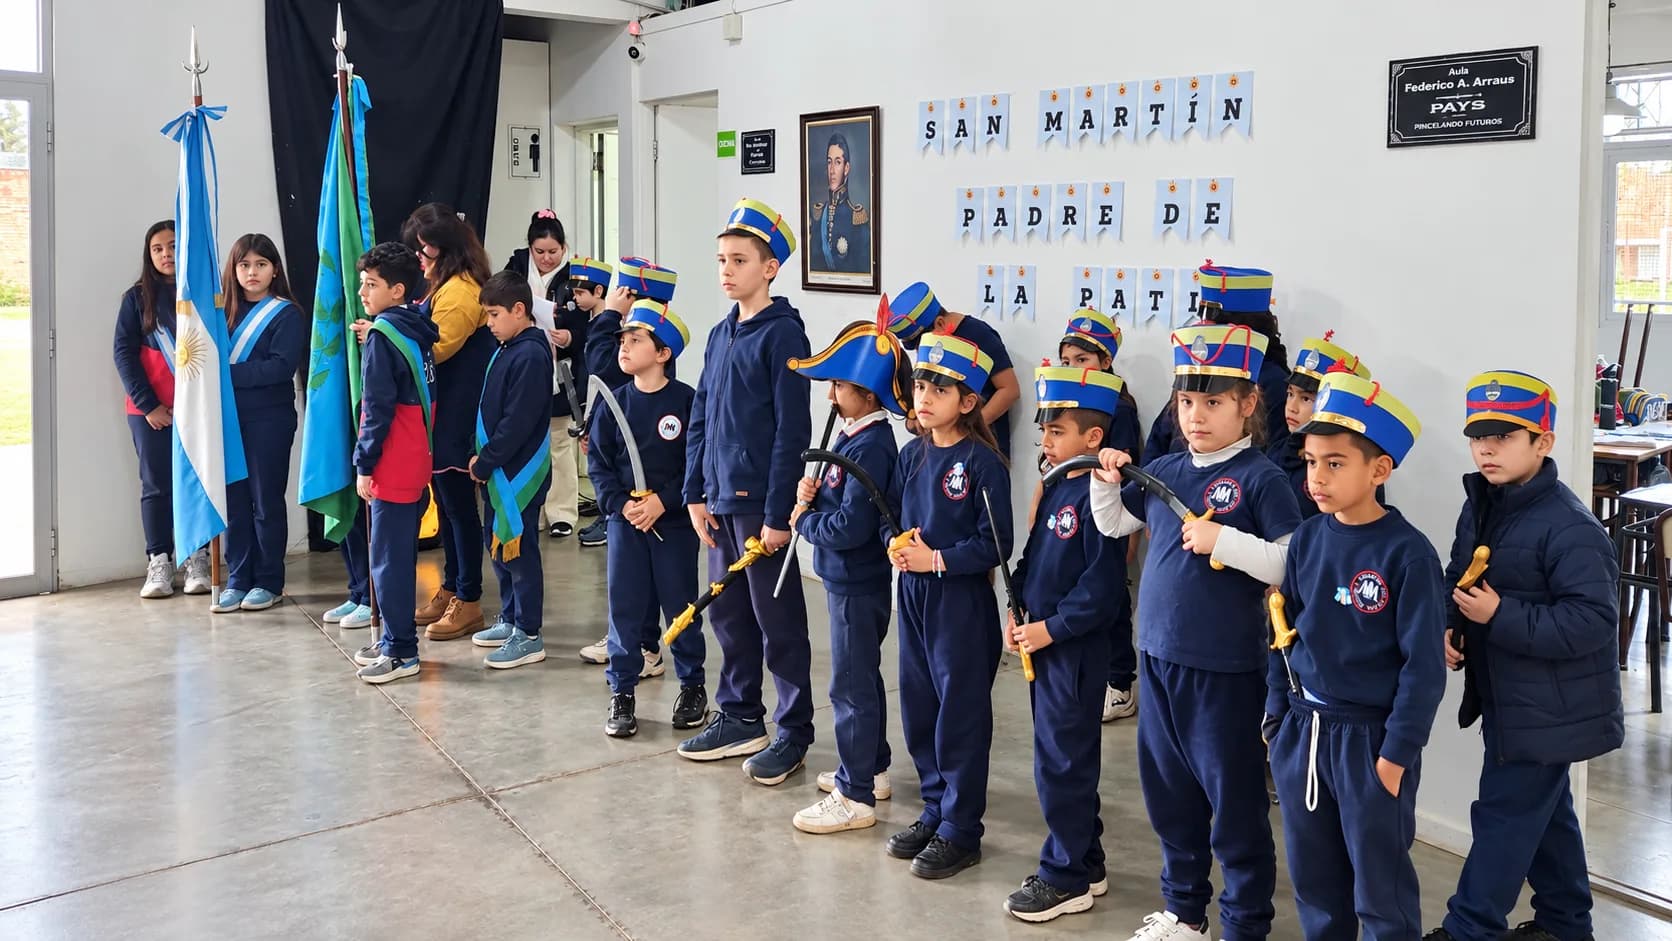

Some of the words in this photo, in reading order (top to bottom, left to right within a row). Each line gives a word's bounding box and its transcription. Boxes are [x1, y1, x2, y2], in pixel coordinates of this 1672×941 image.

[1448, 66, 1469, 76] Aula
[1404, 81, 1454, 92] Federico
[1457, 79, 1470, 88] A.
[1473, 75, 1515, 87] Arraus
[1429, 100, 1486, 114] PAYS
[925, 115, 1002, 139] SAN
[1044, 93, 1242, 132] MARTÍN
[1414, 120, 1464, 130] PINCELANDO
[1465, 118, 1503, 127] FUTUROS
[963, 205, 1113, 228] PADRE
[1163, 202, 1221, 225] DE
[984, 285, 1029, 304] LA
